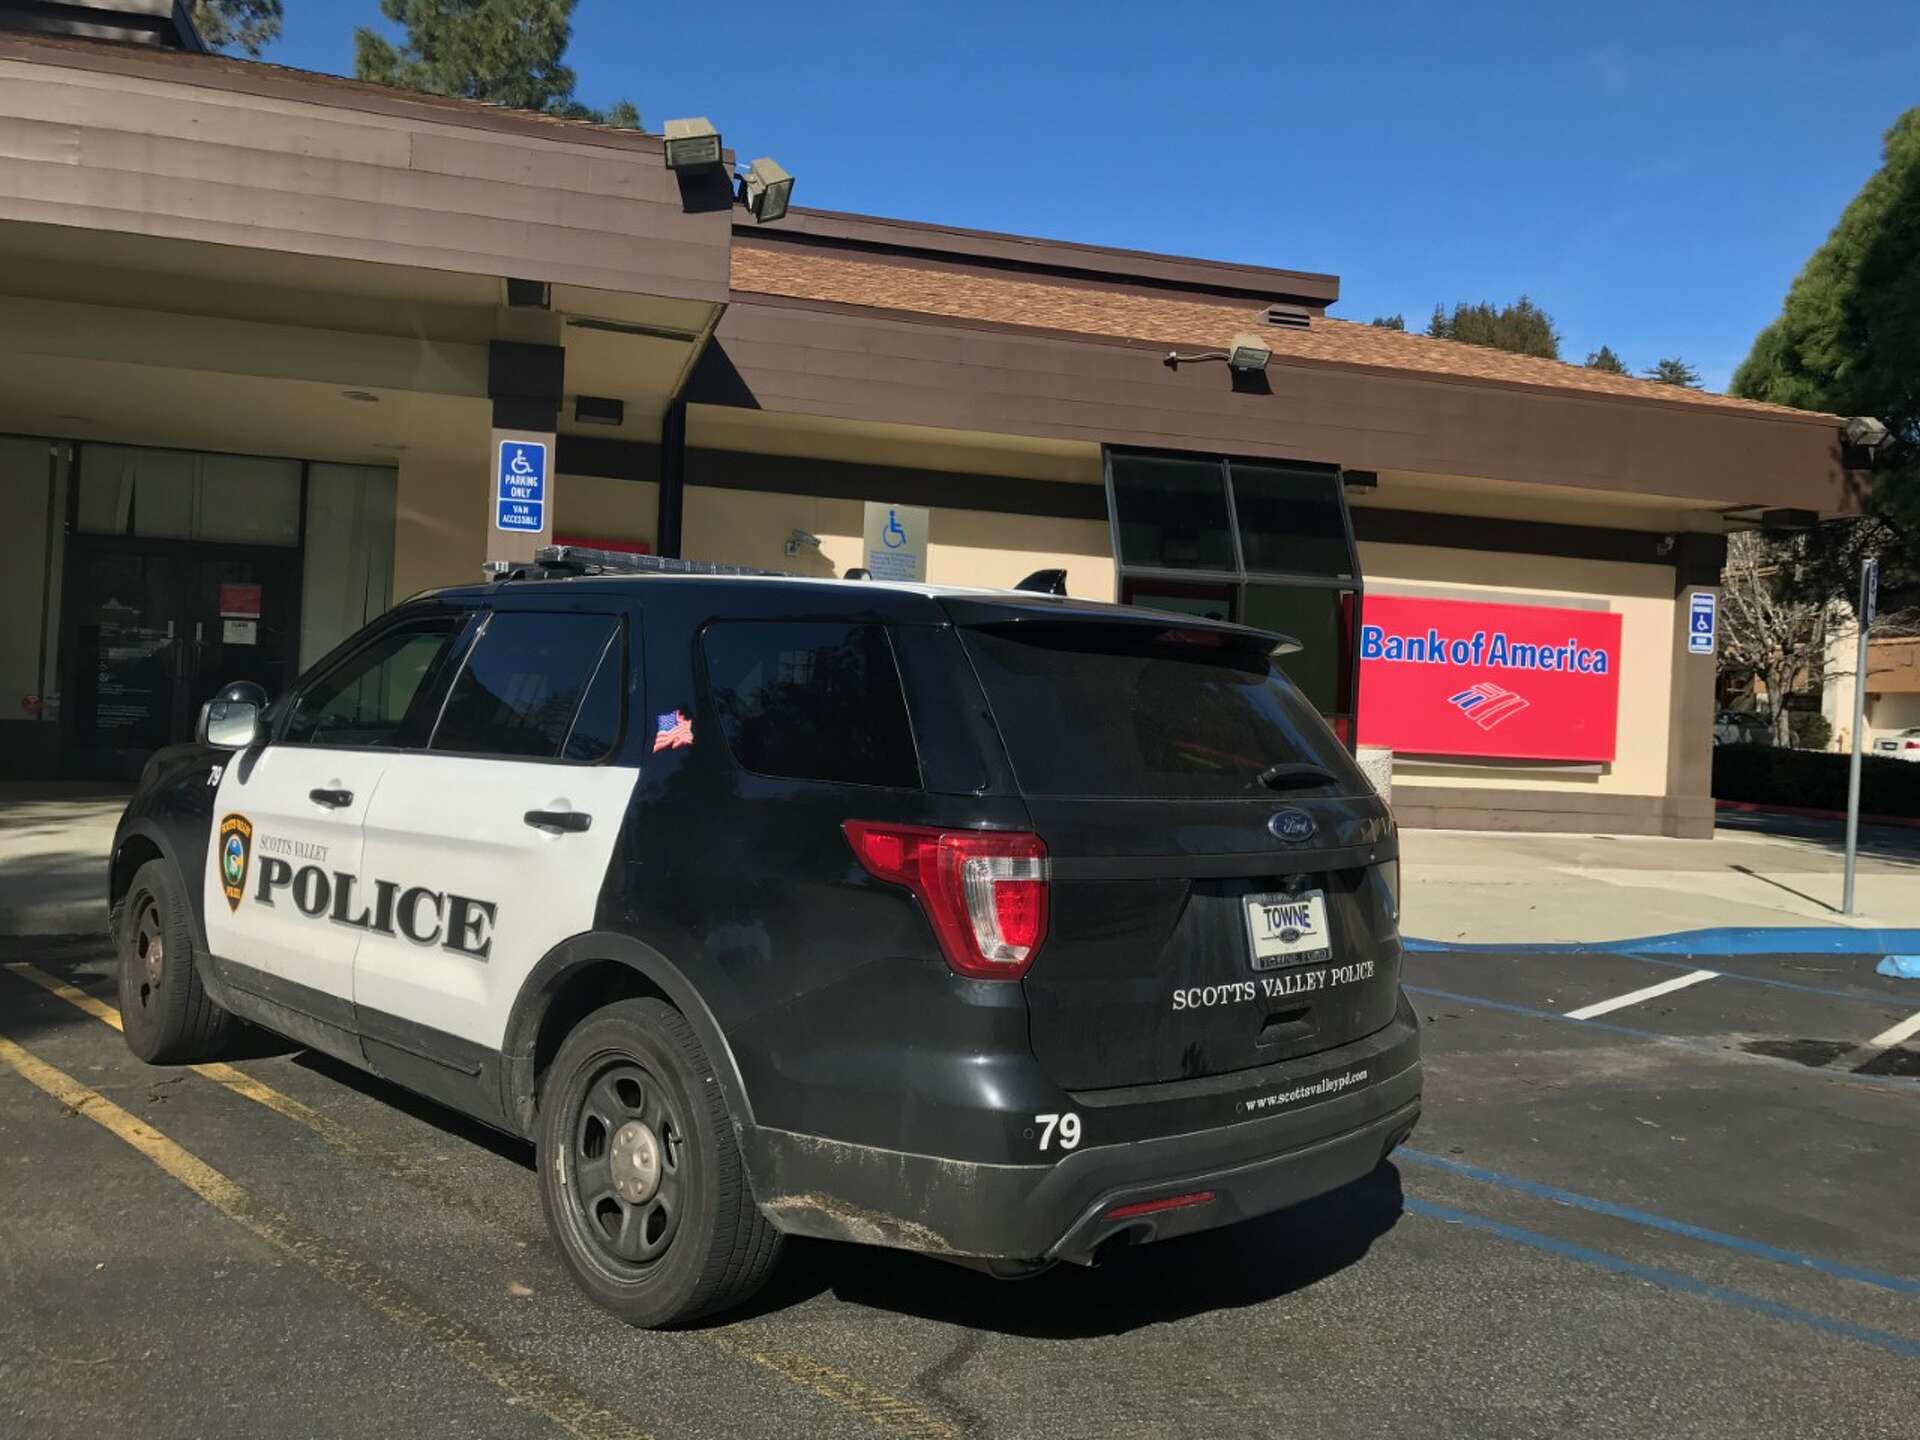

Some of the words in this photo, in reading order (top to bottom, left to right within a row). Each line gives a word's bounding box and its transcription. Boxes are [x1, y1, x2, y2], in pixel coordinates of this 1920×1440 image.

[505, 474, 538, 487] PARKING
[511, 486, 532, 498] ONLY
[503, 514, 537, 525] ACCESSIBLE
[512, 505, 529, 514] VAN
[1360, 625, 1447, 664] Bank
[1450, 631, 1485, 666] of
[1487, 633, 1608, 675] America
[206, 765, 223, 787] 79
[1283, 815, 1308, 833] Ford
[258, 834, 293, 856] SCOTTS
[293, 839, 329, 862] VALLEY
[254, 855, 499, 963] POLICE
[1263, 904, 1312, 932] TOWNE
[1172, 980, 1256, 1010] SCOTTS
[1261, 969, 1327, 998] VALLEY
[1331, 961, 1375, 987] POLICE
[1245, 1069, 1368, 1112] www.scottsvalleypd.com
[1034, 1112, 1082, 1150] 79
